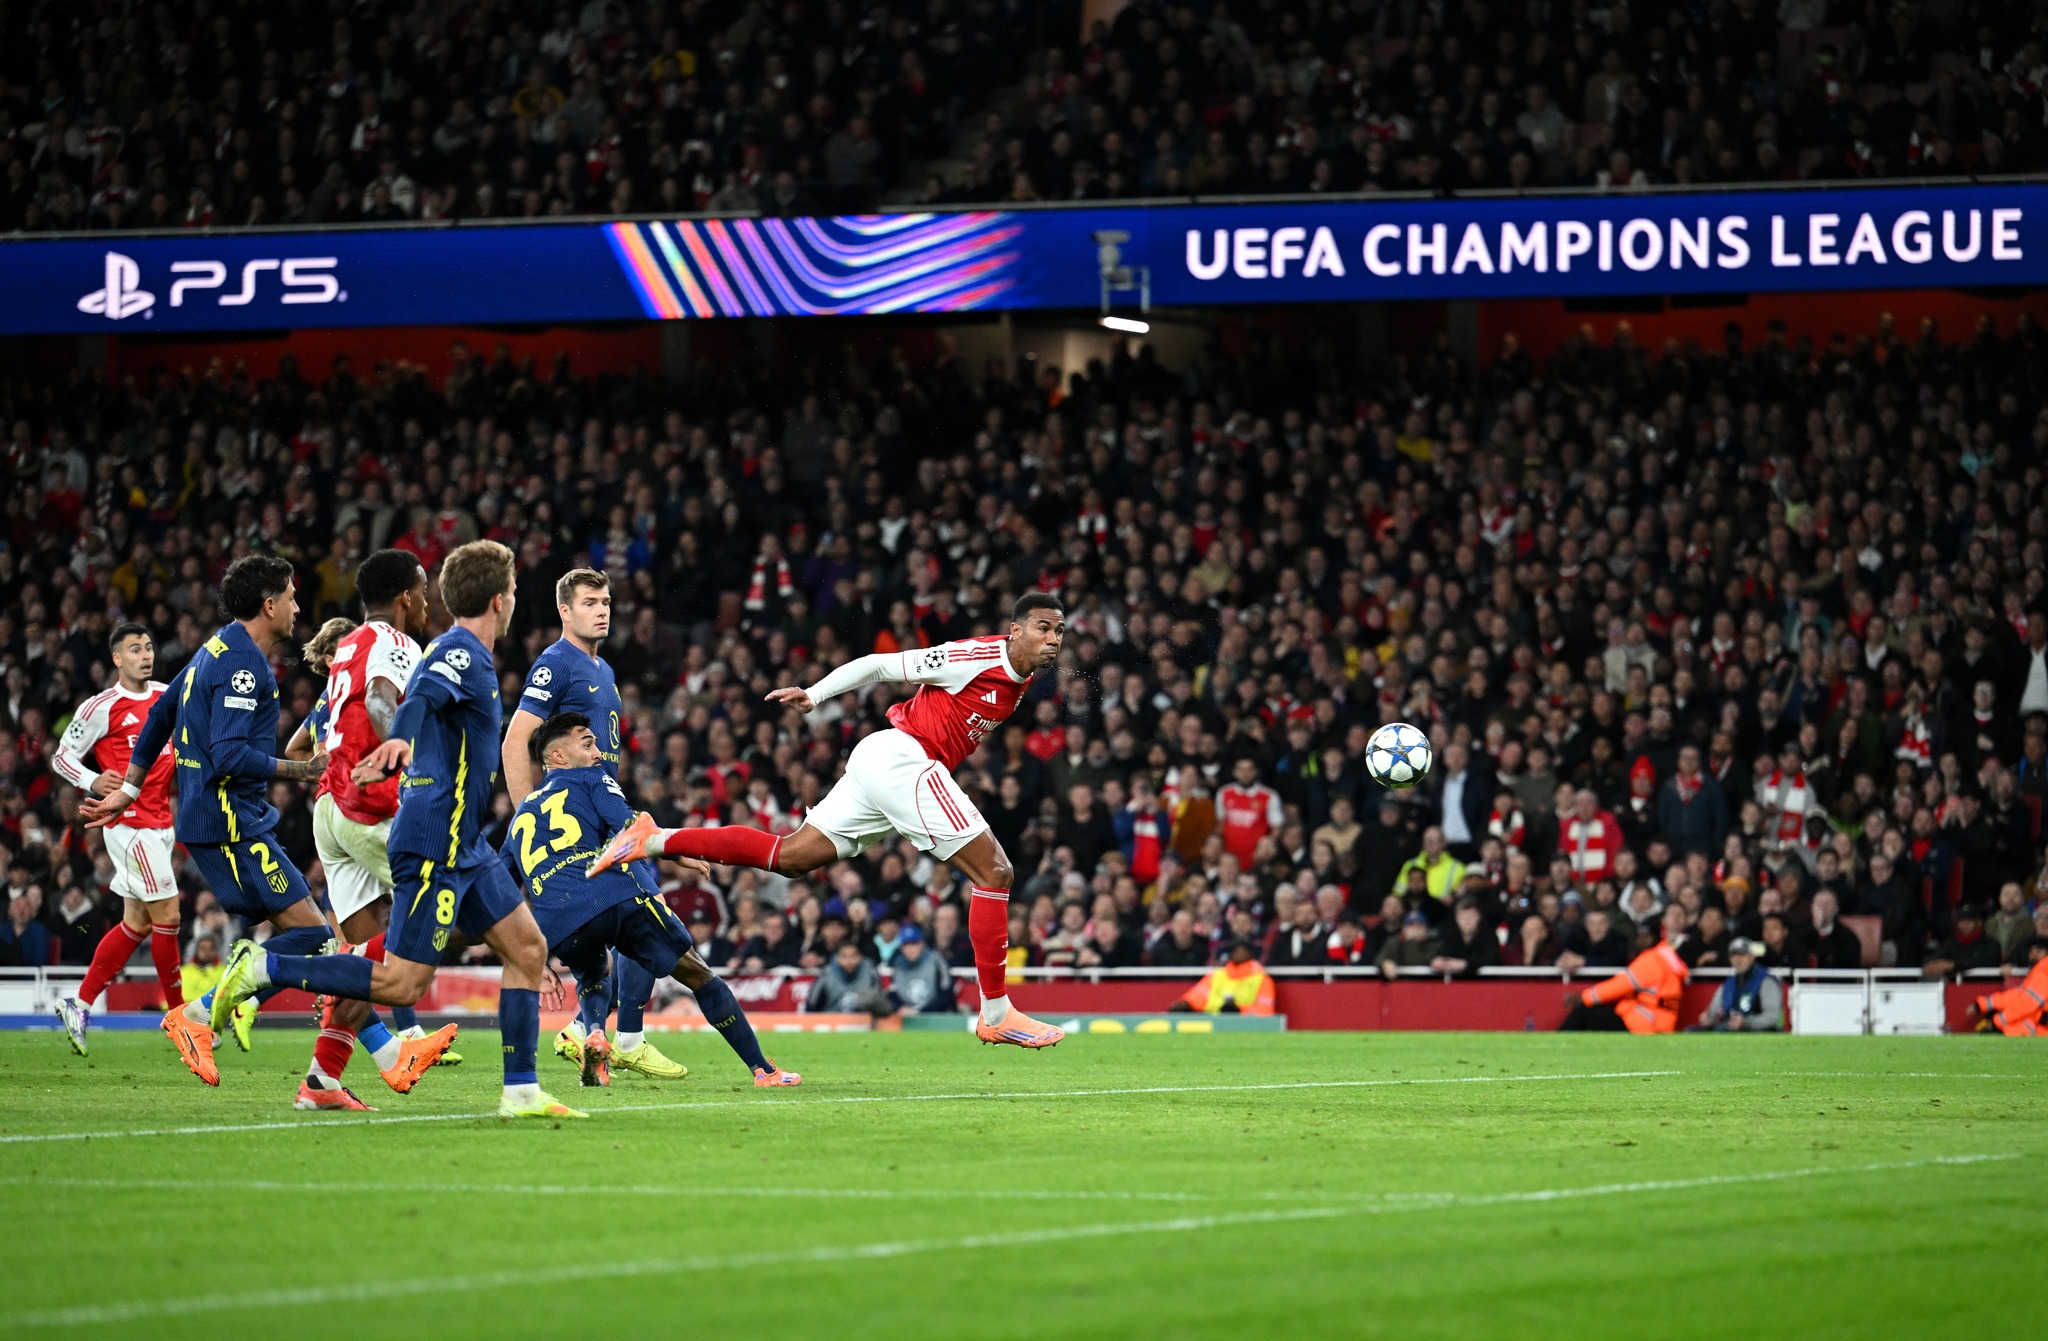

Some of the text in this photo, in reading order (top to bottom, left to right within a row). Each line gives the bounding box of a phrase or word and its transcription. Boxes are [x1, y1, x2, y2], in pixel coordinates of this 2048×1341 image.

[1186, 208, 2023, 280] UEFA CHAMPIONS LEAGUE
[170, 257, 339, 307] PS5
[510, 788, 583, 877] 23
[249, 842, 279, 875] 2
[540, 851, 597, 881] Save the Childre
[435, 889, 456, 925] 8
